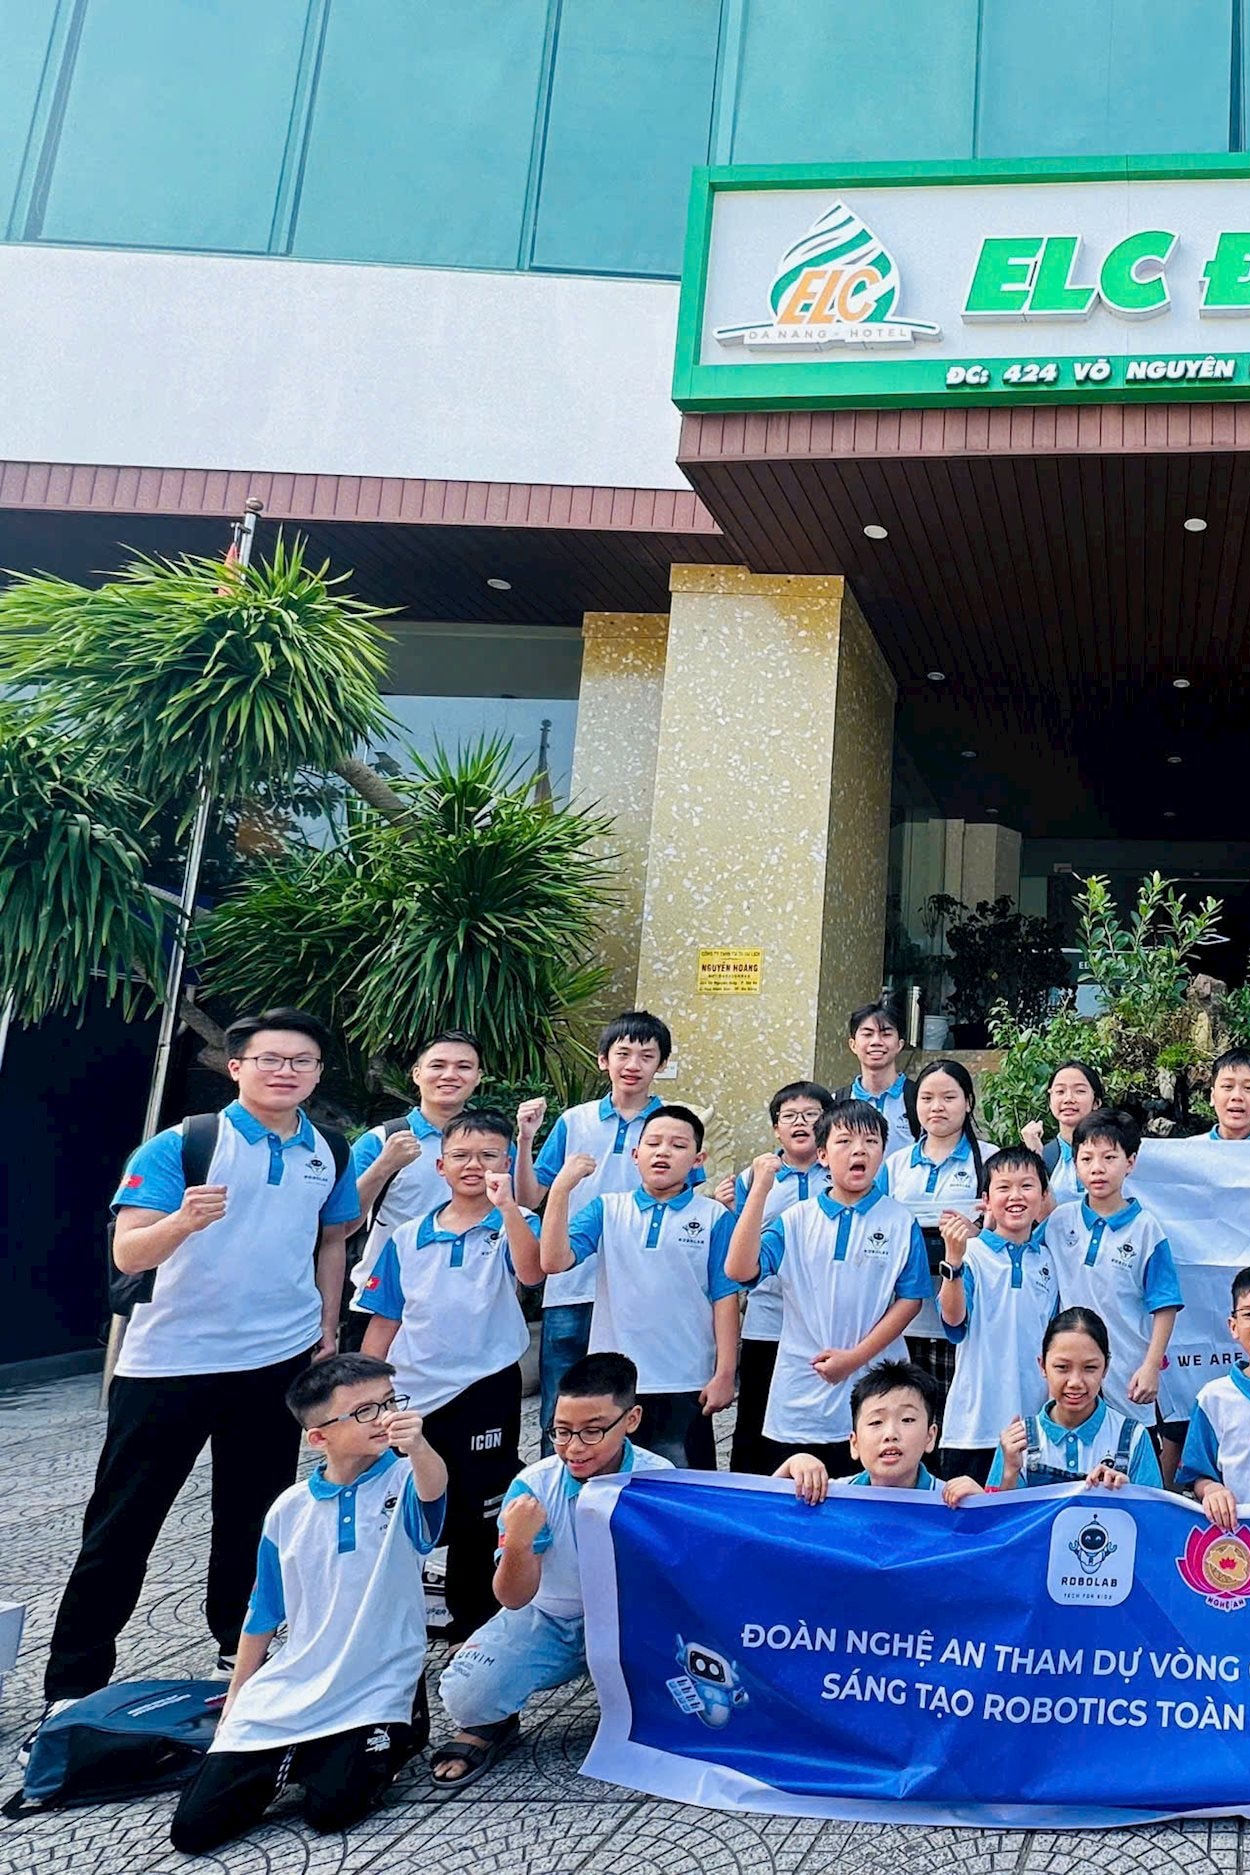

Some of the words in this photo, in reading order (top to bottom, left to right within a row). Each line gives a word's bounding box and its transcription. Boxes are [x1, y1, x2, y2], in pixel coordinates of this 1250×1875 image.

[963, 230, 1180, 319] ELC
[777, 268, 880, 325] ELC
[778, 329, 827, 339] NANG
[850, 328, 907, 338] HOTEL
[946, 365, 989, 386] ĐC:
[1003, 363, 1058, 384] 424
[1073, 358, 1112, 382] VÕ
[1126, 354, 1235, 381] NGUYÊN
[1177, 1354, 1202, 1368] WE
[471, 1430, 502, 1451] ICON
[1061, 1576, 1118, 1588] ROBOLAB
[741, 1619, 838, 1653] ĐOÀN
[846, 1629, 935, 1668] NGHỆ
[939, 1638, 986, 1669] AN
[994, 1644, 1084, 1676] THAM
[1093, 1647, 1143, 1685] DỰ
[1149, 1646, 1240, 1683] VÒNG
[821, 1667, 907, 1706] SÁNG
[915, 1682, 974, 1720] TẠO
[983, 1694, 1148, 1728] ROBOTICS
[1157, 1696, 1245, 1732] TOÀN
